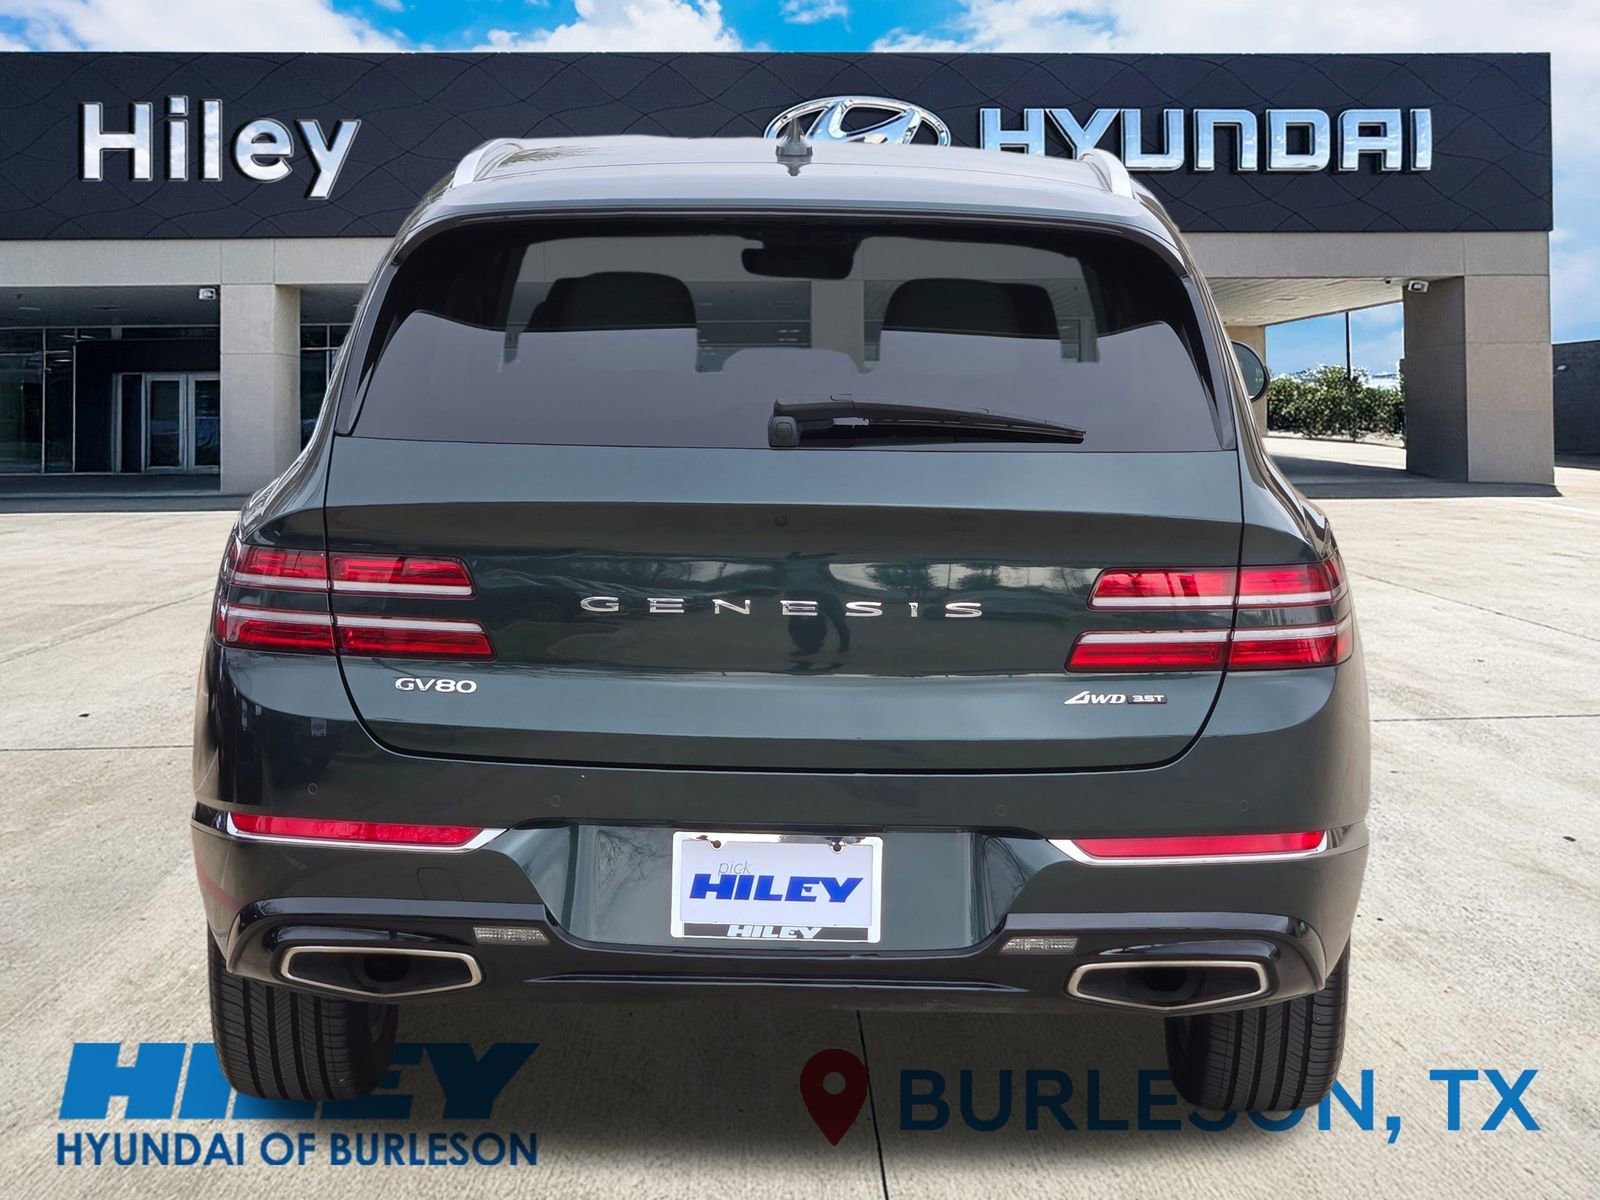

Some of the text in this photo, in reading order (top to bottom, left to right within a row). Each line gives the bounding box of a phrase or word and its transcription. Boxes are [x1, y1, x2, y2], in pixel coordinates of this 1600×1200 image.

[79, 95, 361, 199] Hiley
[980, 108, 1431, 171] HYUNDAI
[580, 596, 983, 618] GENESIS
[394, 676, 478, 694] GV80
[1064, 690, 1126, 704] AWD
[718, 860, 752, 876] pick
[689, 873, 864, 903] HILEY
[727, 924, 822, 939] HILEY
